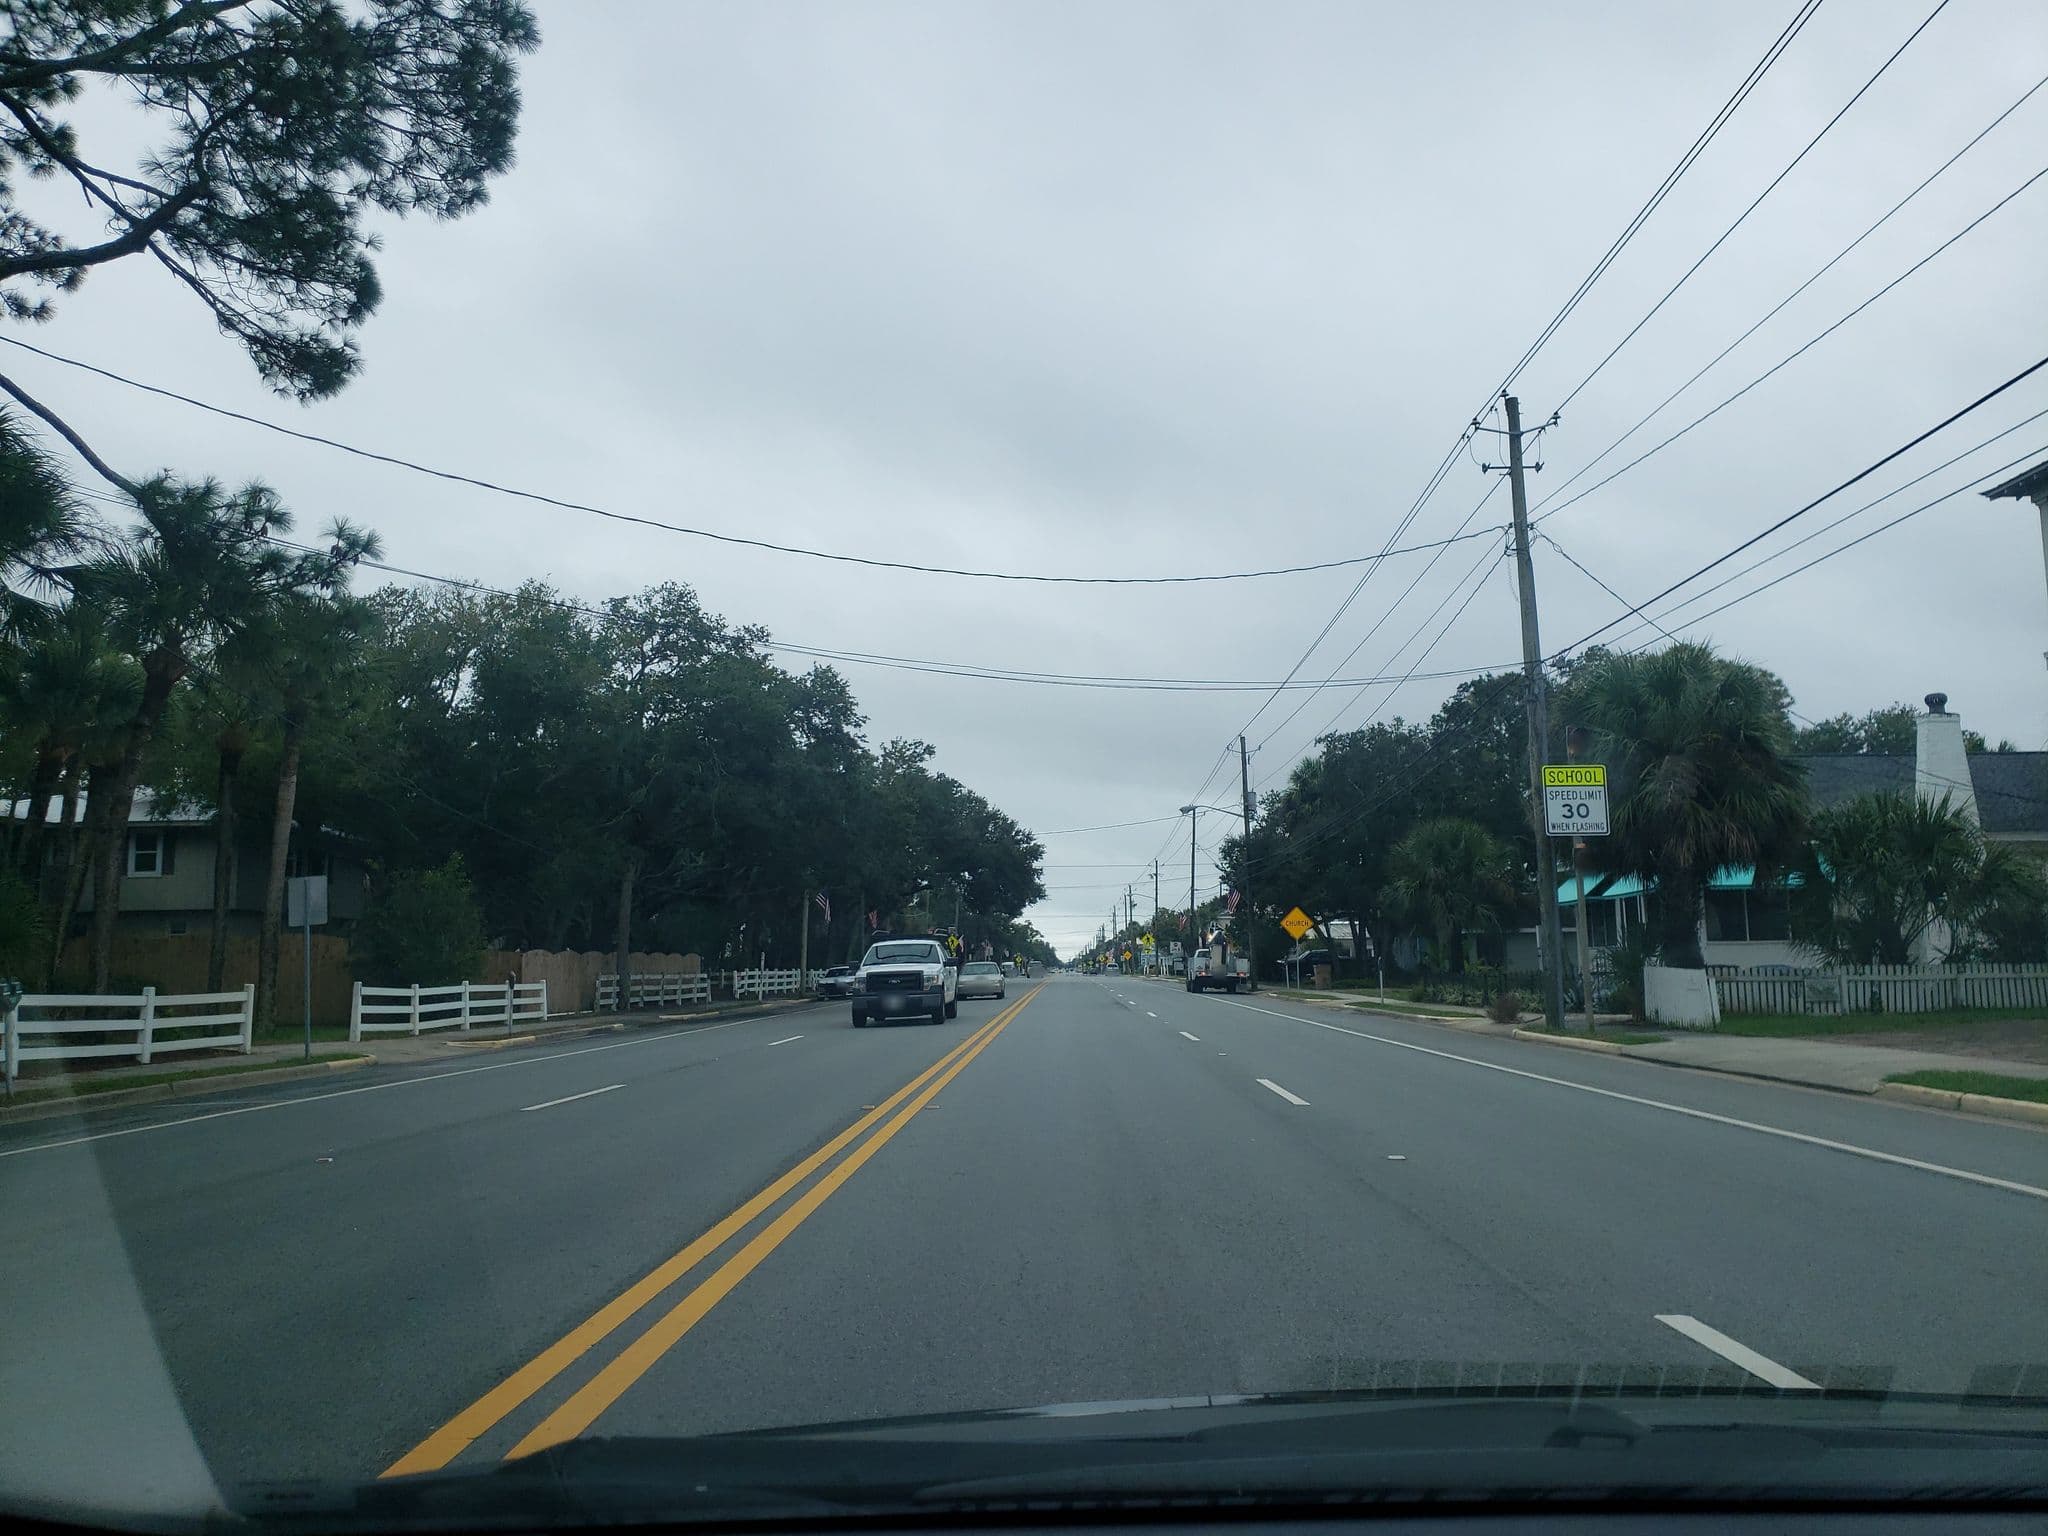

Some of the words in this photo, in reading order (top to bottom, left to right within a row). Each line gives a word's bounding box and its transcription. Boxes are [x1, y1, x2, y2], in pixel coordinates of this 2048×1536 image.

[1548, 770, 1601, 783] SCHOOL
[1549, 790, 1577, 800] SPEED
[1579, 790, 1602, 800] LIMIT
[1562, 803, 1590, 819] 30
[1551, 822, 1570, 831] WHEN
[1572, 822, 1605, 831] FLASHING
